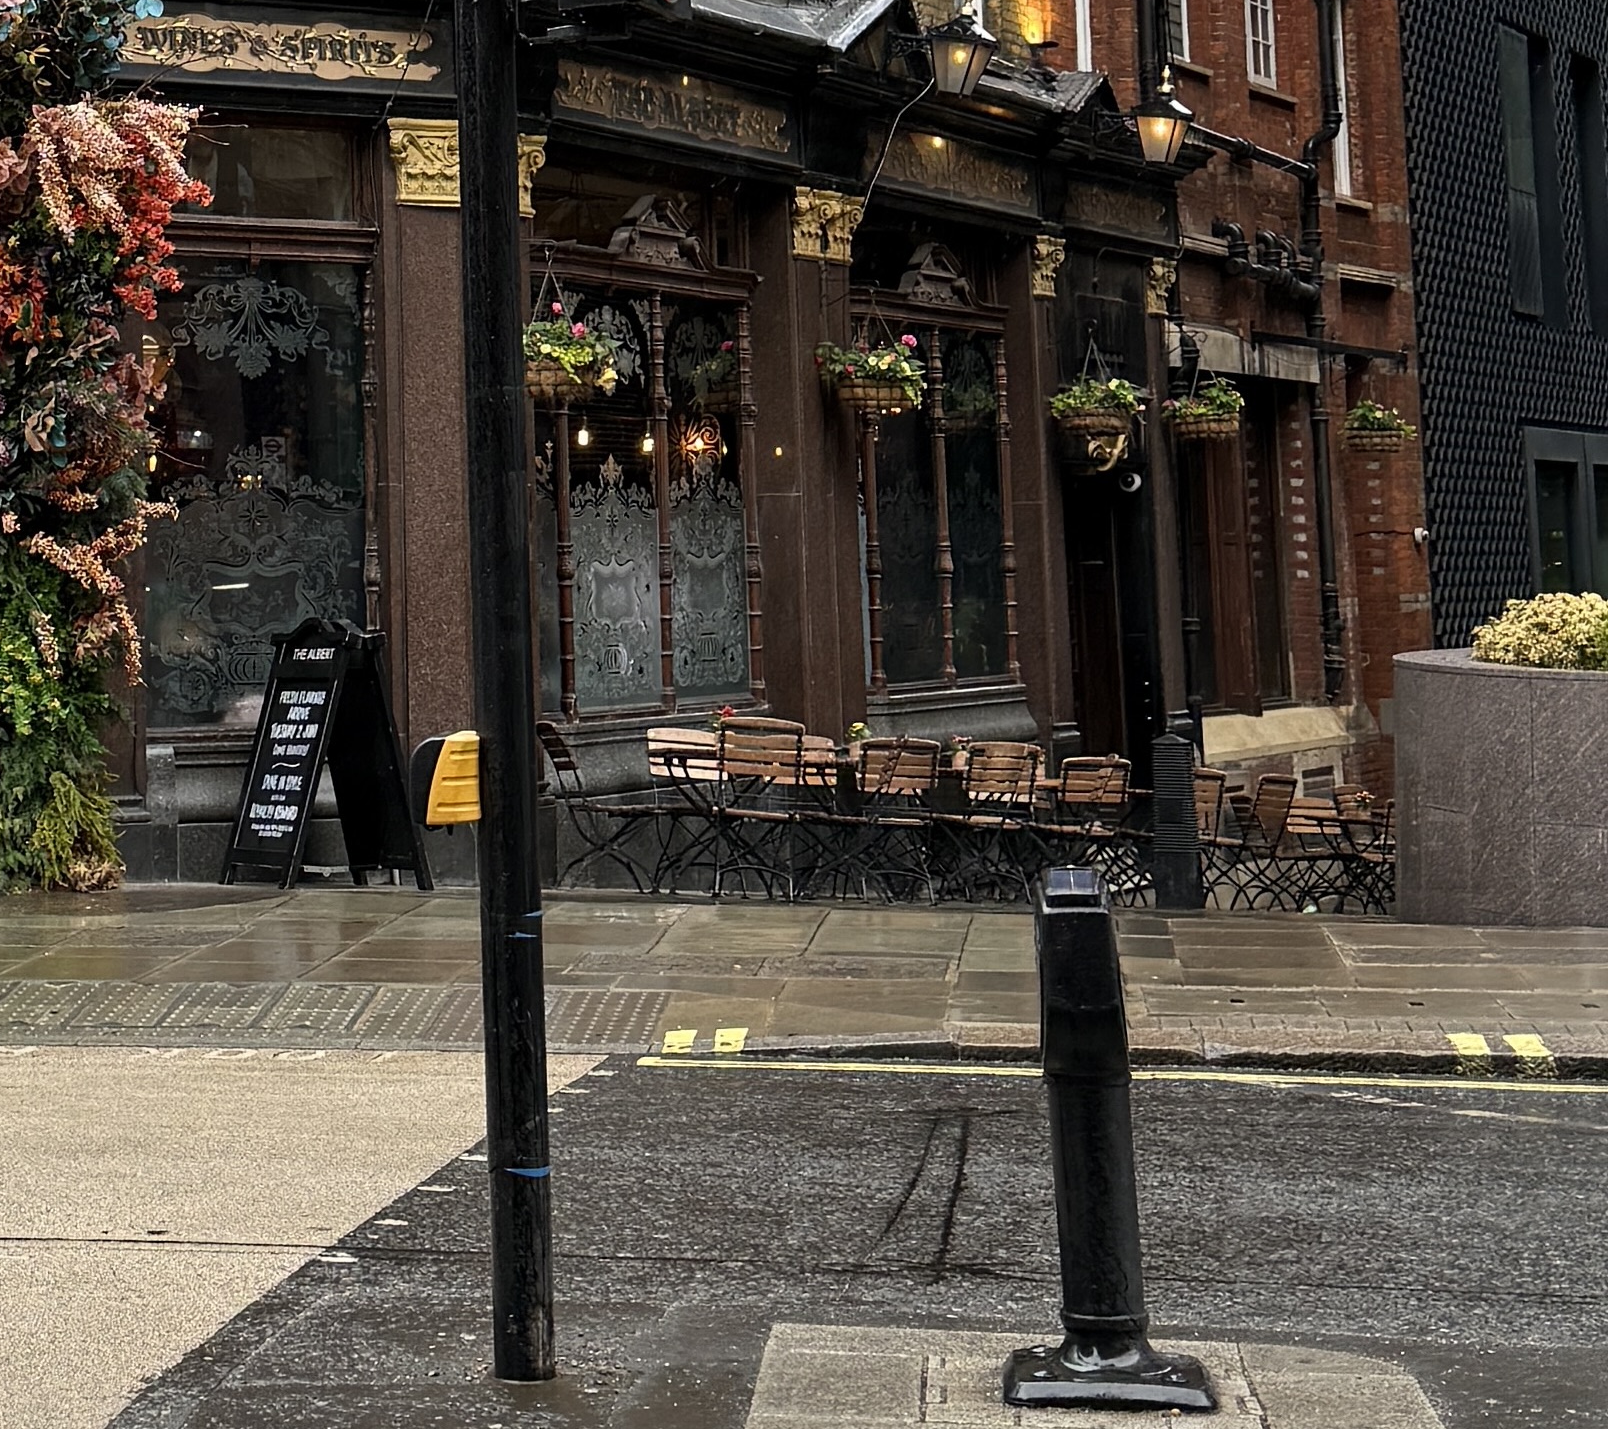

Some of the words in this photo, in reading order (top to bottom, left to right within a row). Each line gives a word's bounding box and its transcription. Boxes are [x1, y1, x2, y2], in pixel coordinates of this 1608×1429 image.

[136, 26, 240, 58] WINES
[280, 33, 398, 65] SPIRITS
[293, 648, 308, 660] THE
[307, 647, 336, 660] ALBERT
